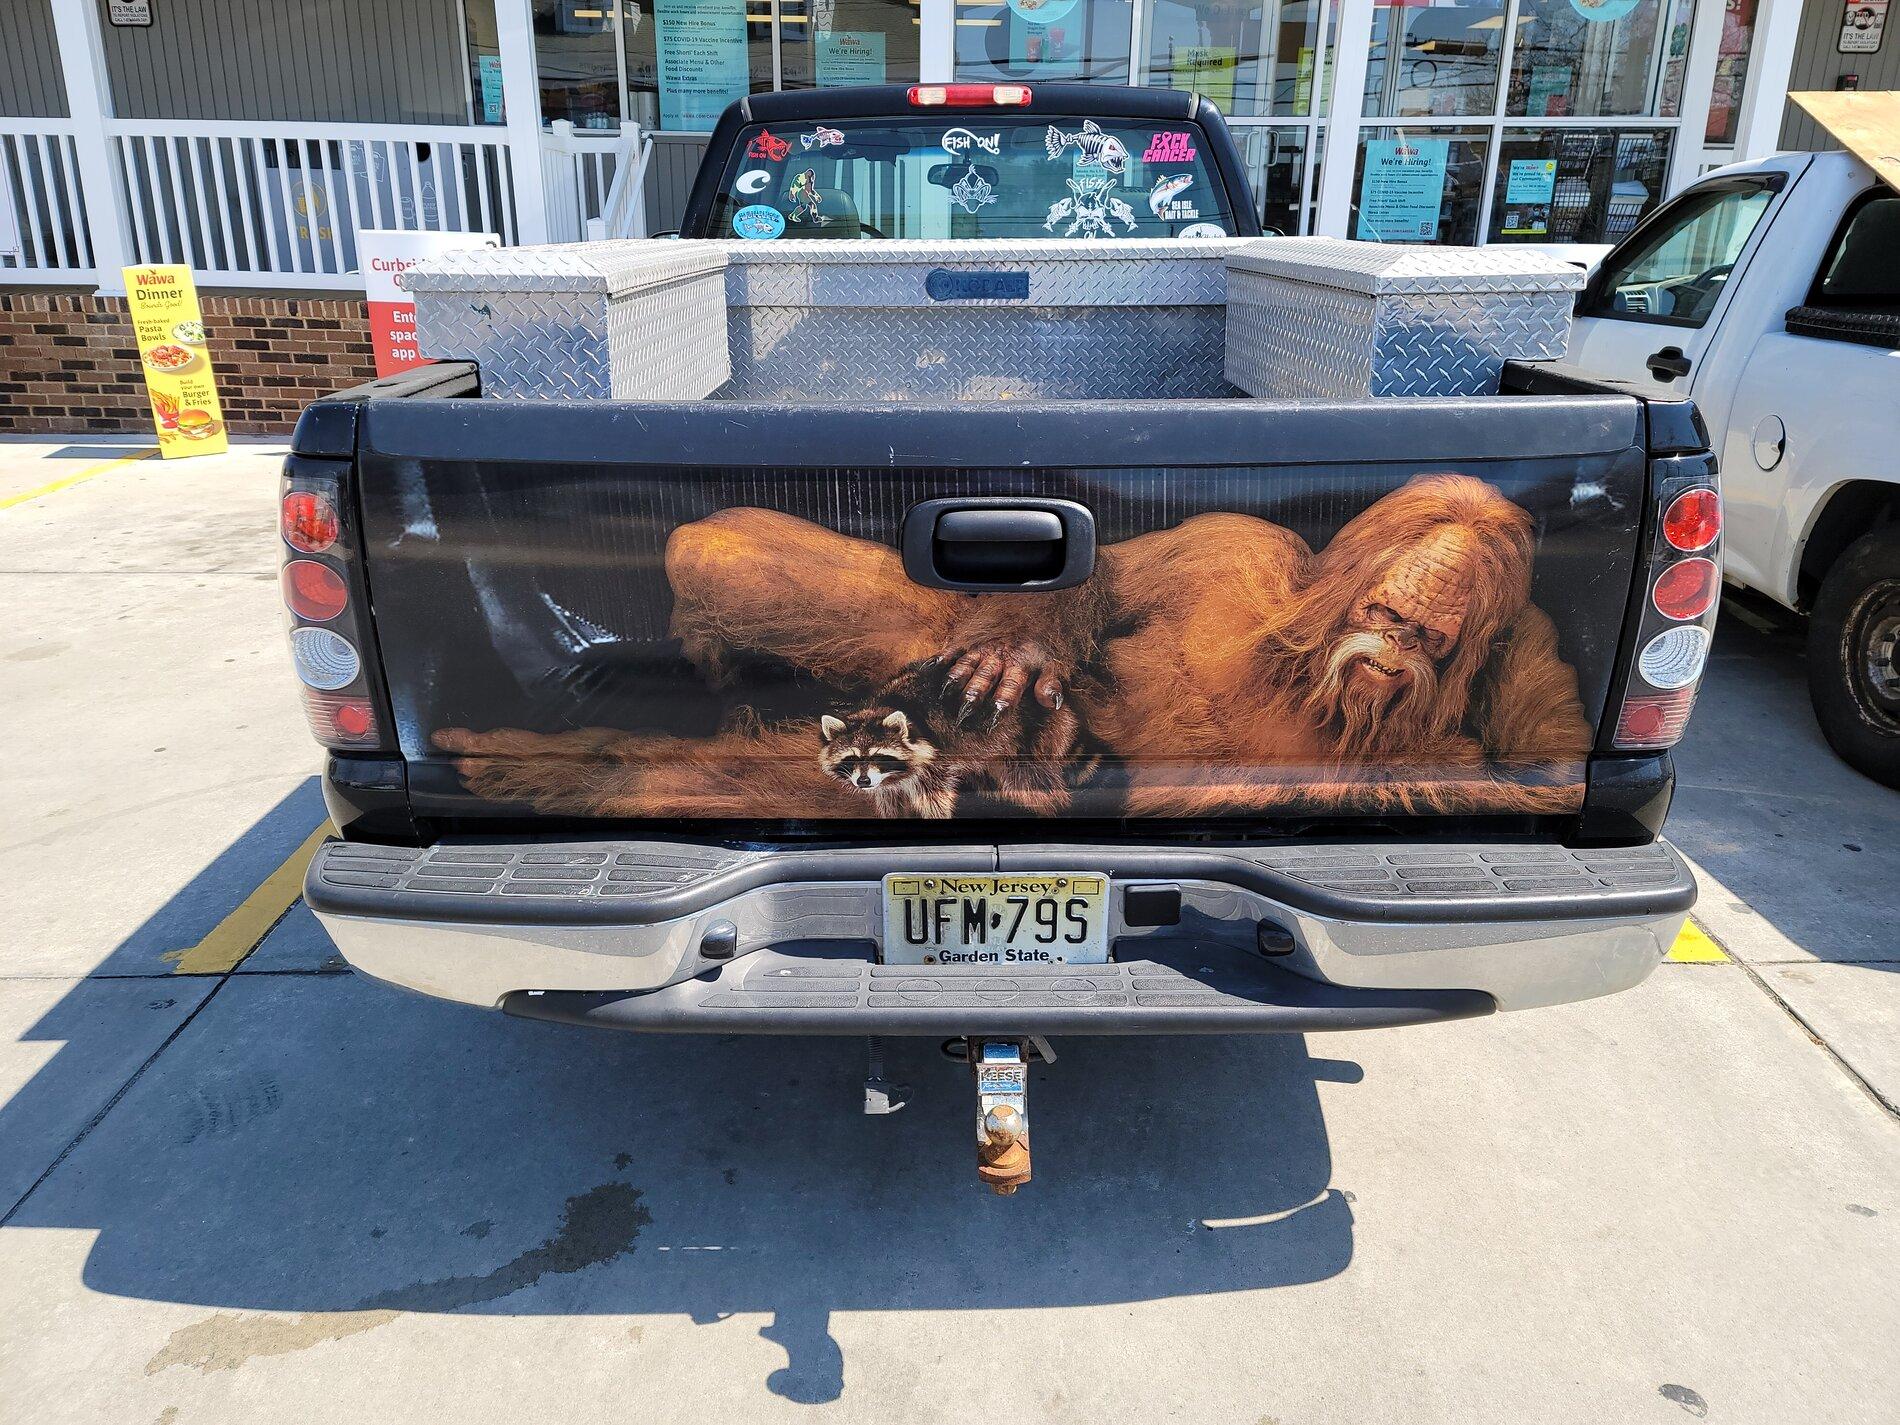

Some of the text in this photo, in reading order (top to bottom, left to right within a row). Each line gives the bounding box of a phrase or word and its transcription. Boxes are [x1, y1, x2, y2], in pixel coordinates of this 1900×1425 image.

[829, 47, 873, 56] We're Hiring!
[1187, 49, 1208, 57] Mask
[1187, 57, 1223, 67] Required
[944, 133, 1000, 150] FISH ON!
[1142, 148, 1197, 163] CANCER
[1395, 146, 1419, 156] Wawa
[1381, 158, 1432, 168] We're Hiring!
[1079, 177, 1105, 192] FISH
[1171, 200, 1193, 210] SEA ISLE
[1164, 209, 1199, 220] BAIT & TACKLE
[371, 257, 420, 272] Curbsi
[136, 273, 176, 286] Wawa
[135, 289, 183, 301] Dinner
[392, 310, 418, 323] Ent
[139, 325, 163, 333] Pasta
[140, 334, 167, 342] Bowls
[390, 329, 418, 344] spac
[391, 348, 417, 360] app
[182, 389, 210, 399] Burger
[184, 399, 212, 407] & Fries
[939, 879, 1053, 897] New Jersey
[903, 897, 1090, 945] UFM 79S
[938, 949, 1050, 963] Garden State
